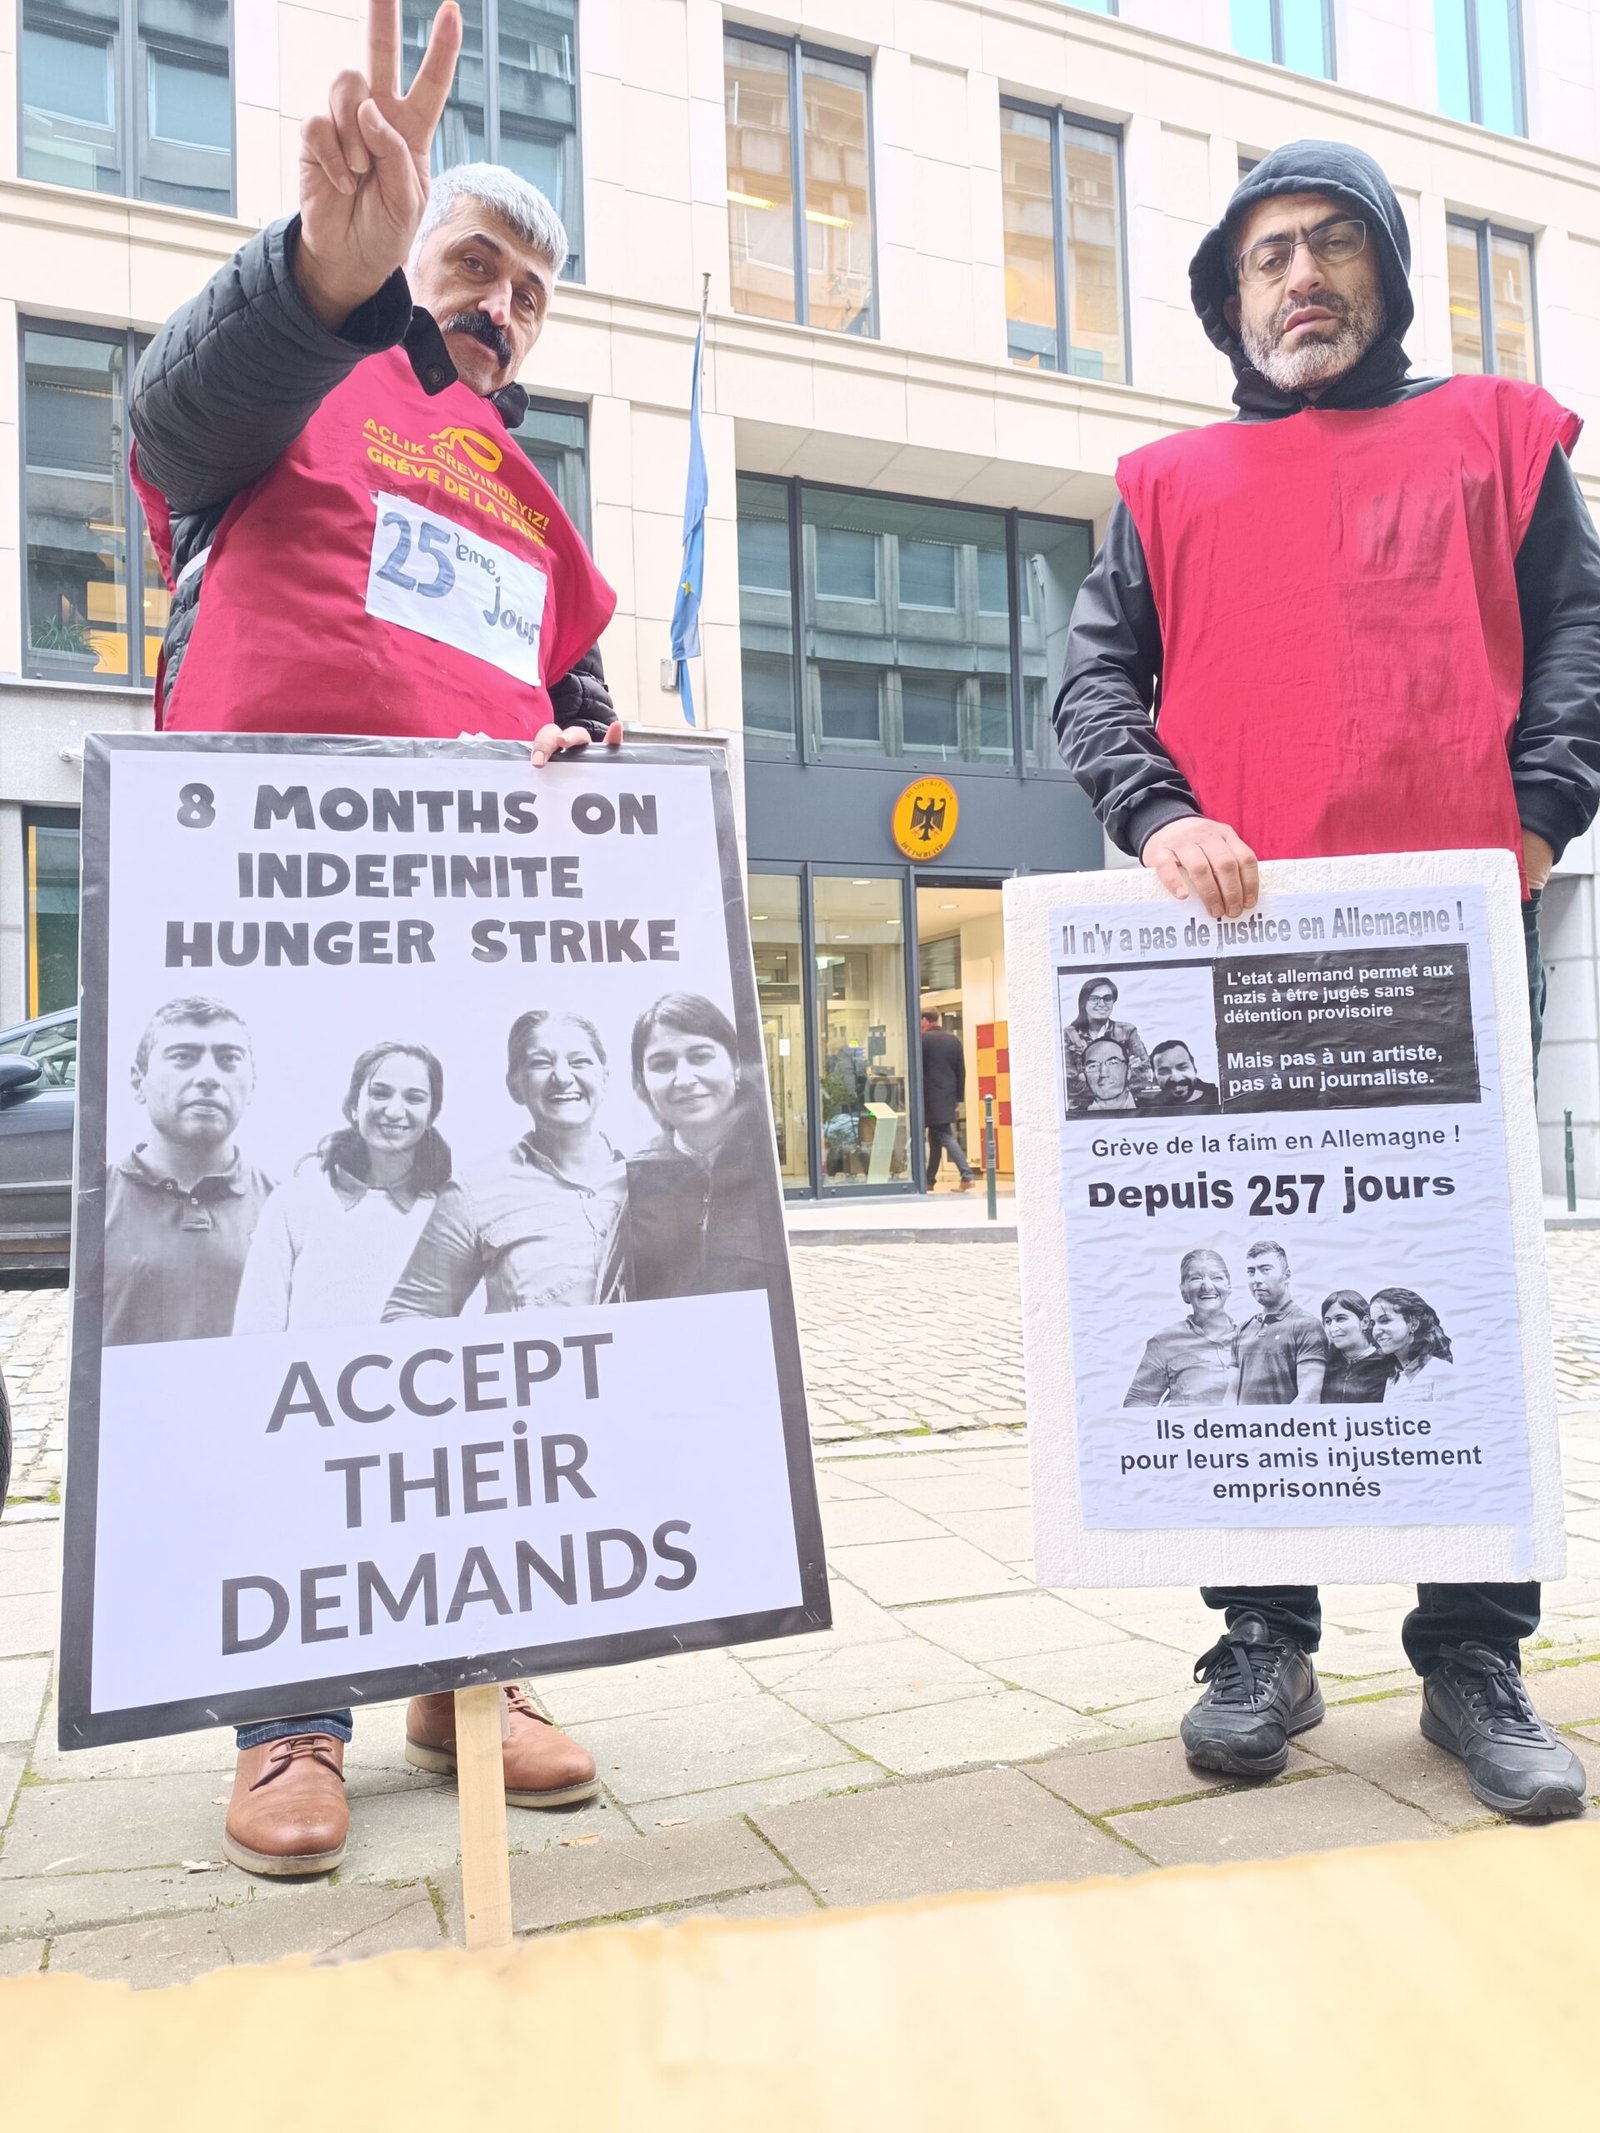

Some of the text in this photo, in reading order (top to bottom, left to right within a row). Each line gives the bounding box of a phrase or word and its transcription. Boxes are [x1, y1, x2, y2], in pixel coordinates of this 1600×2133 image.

[363, 417, 426, 456] AÇLIK
[444, 477, 470, 502] DE
[475, 493, 499, 518] LA
[482, 575, 541, 646] jour
[177, 783, 659, 835] 8 MONTHS ON
[237, 852, 584, 899] INDEFINITE
[164, 918, 680, 968] HUNGER STRIKE
[1062, 925, 1076, 955] Il
[1119, 928, 1133, 951] a
[1139, 925, 1177, 957] pas
[1184, 917, 1211, 947] de
[1216, 912, 1292, 953] justice
[1299, 915, 1325, 940] en
[1331, 907, 1451, 942] Allemagne
[1456, 900, 1464, 931] !
[1223, 984, 1415, 1005] nazis à être jugés sans
[1227, 963, 1454, 987] L'etat allemand permet aux
[1224, 1003, 1393, 1025] détention provisoire
[1226, 1044, 1443, 1071] Mais pas à un artiste,
[1228, 1068, 1435, 1097] pas à un journaliste.
[1091, 1124, 1461, 1157] Grève de la faim en Allemagne !
[1088, 1166, 1456, 1217] Depuis 257 jours
[264, 1332, 614, 1434] ACCEPT
[1156, 1415, 1432, 1442] Ils demandent justice
[1120, 1445, 1483, 1475] pour leurs amis injustement
[1212, 1475, 1382, 1504] emprisonnés
[221, 1519, 698, 1656] DEMANDS
